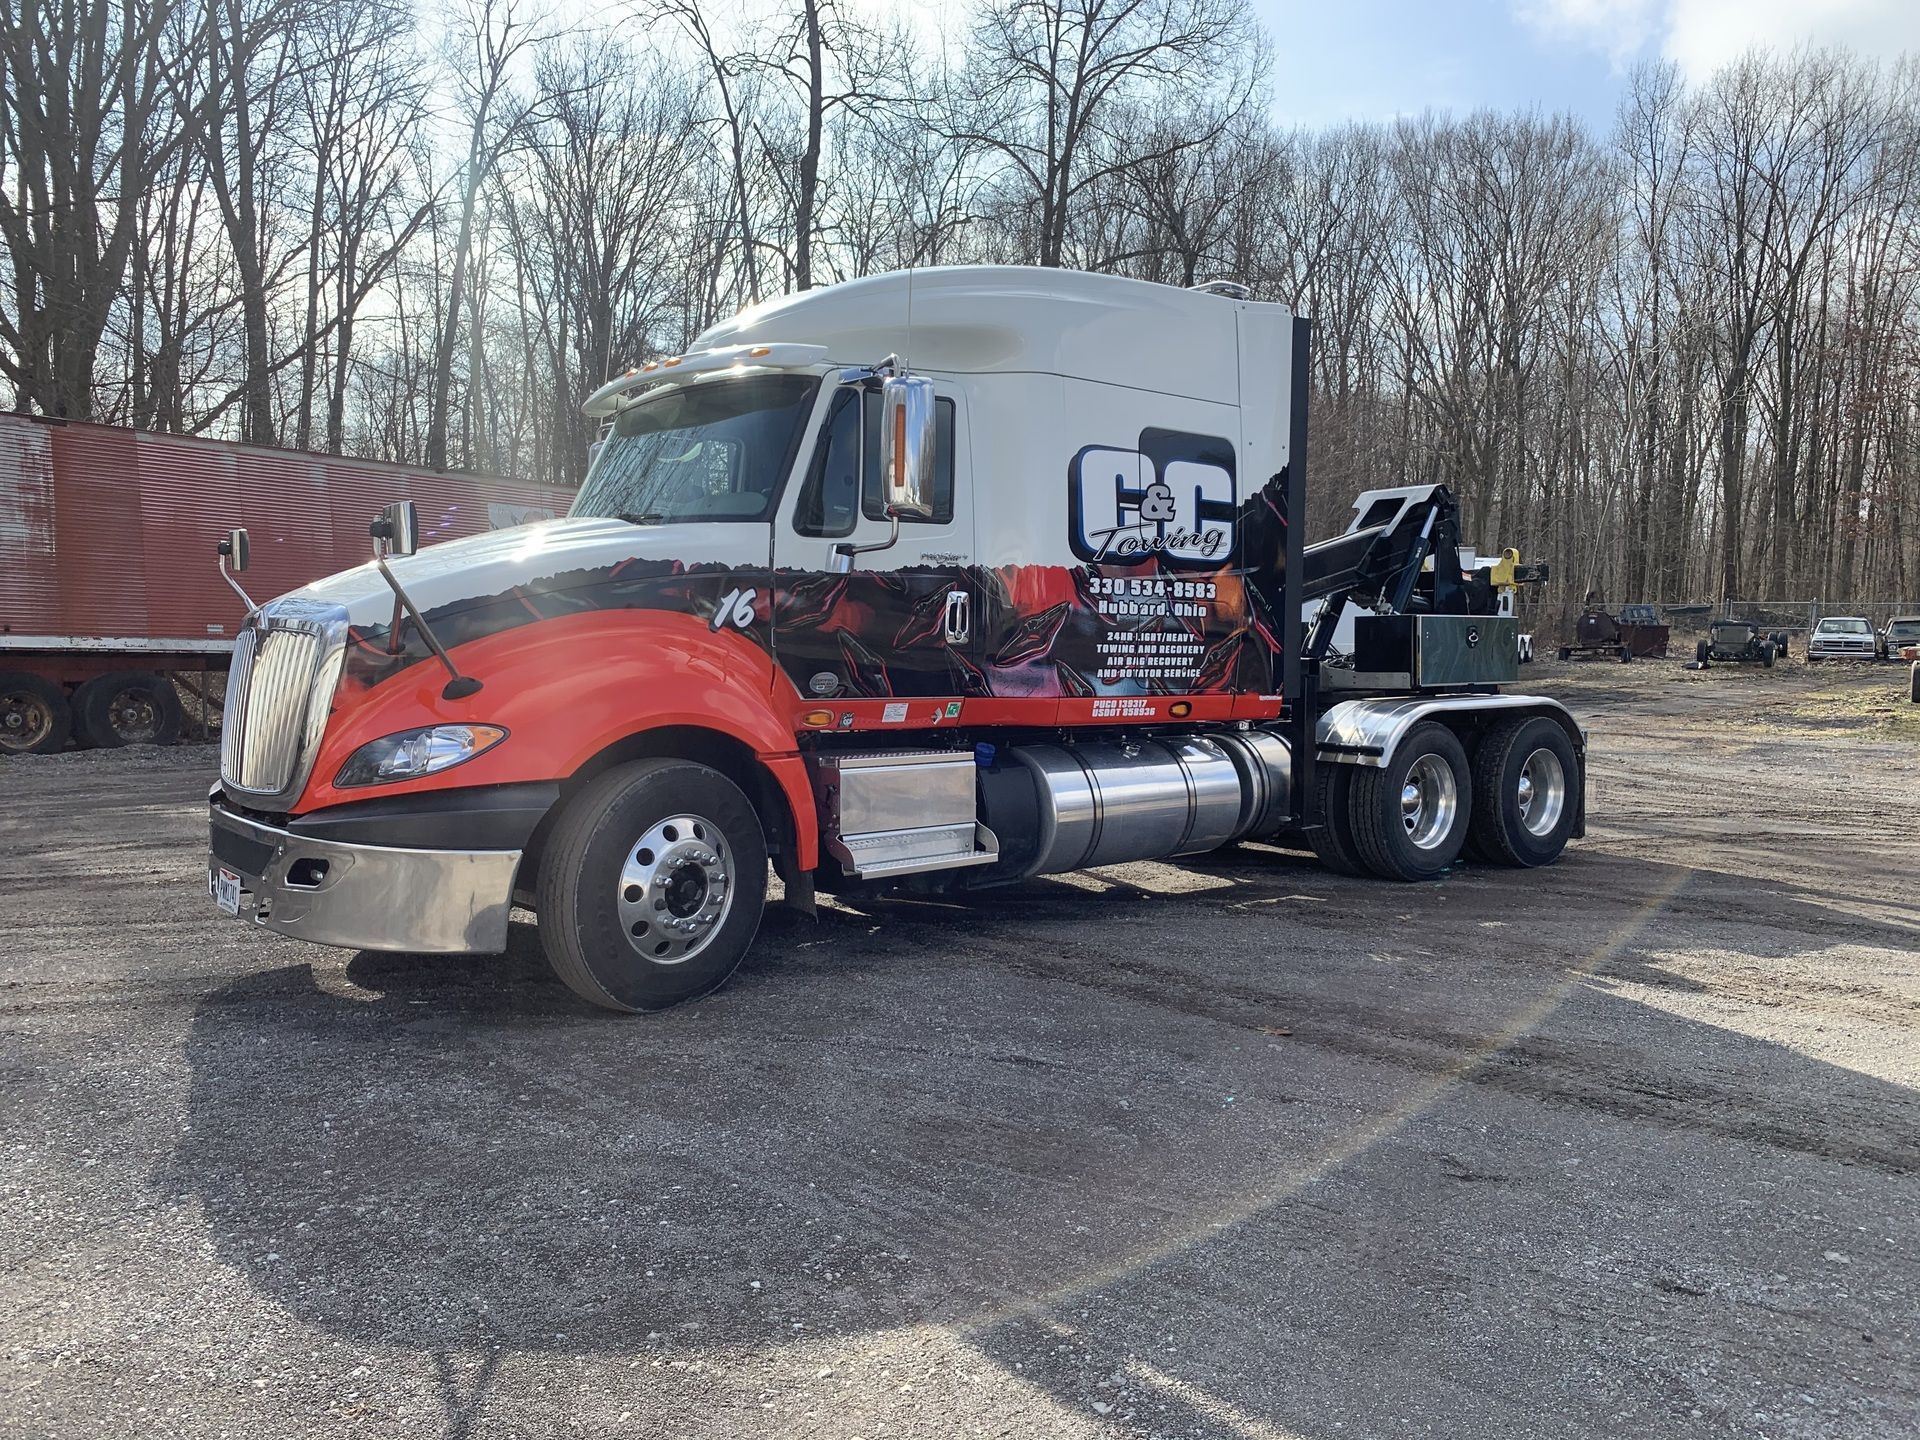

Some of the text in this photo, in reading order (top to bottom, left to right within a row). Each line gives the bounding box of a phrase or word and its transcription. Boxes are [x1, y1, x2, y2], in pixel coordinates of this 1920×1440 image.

[1072, 442, 1236, 564] C&C
[1089, 522, 1227, 562] Towing
[1089, 577, 1217, 599] 330 534-8583
[711, 587, 757, 630] 16
[1098, 600, 1207, 618] Hubbard, Ohio
[1107, 632, 1195, 642] 24HR LIGHT/HEAVY
[1097, 644, 1205, 654] TOWING AND RECOVERY
[1107, 656, 1194, 666] AIR BAG RECOVERY
[1097, 669, 1201, 678] AND ROTATOR SERVICE
[1093, 699, 1148, 708] PUCO 139317
[1092, 708, 1121, 717] USDOT
